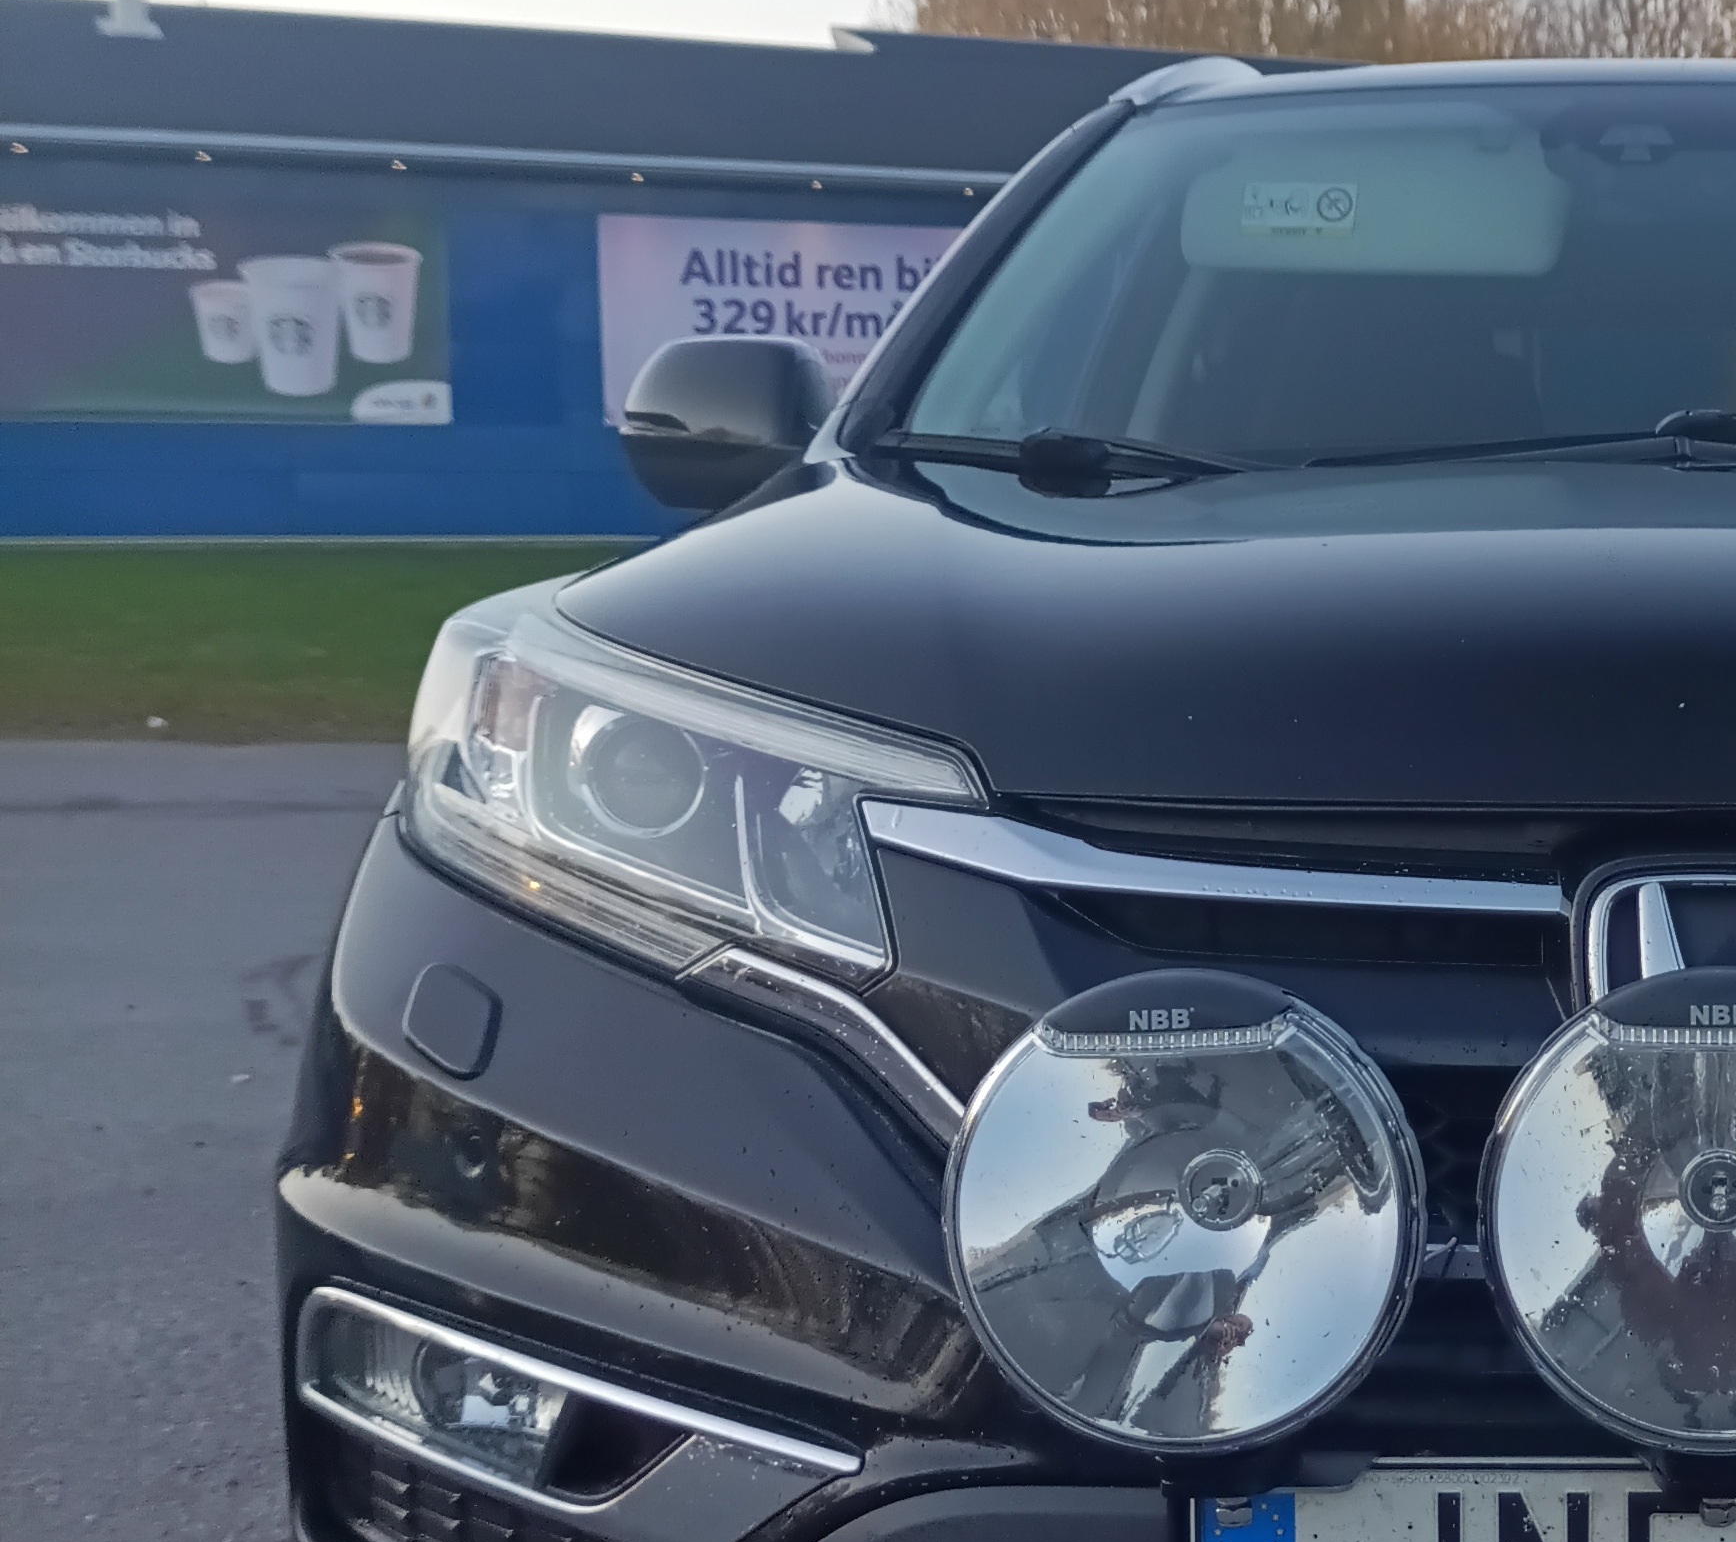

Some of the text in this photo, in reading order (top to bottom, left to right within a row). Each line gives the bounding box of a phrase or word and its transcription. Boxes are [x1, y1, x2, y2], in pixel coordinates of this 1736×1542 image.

[680, 247, 943, 292] Alltid ren bi
[693, 298, 776, 335] 329
[1129, 1008, 1190, 1030] NBB
